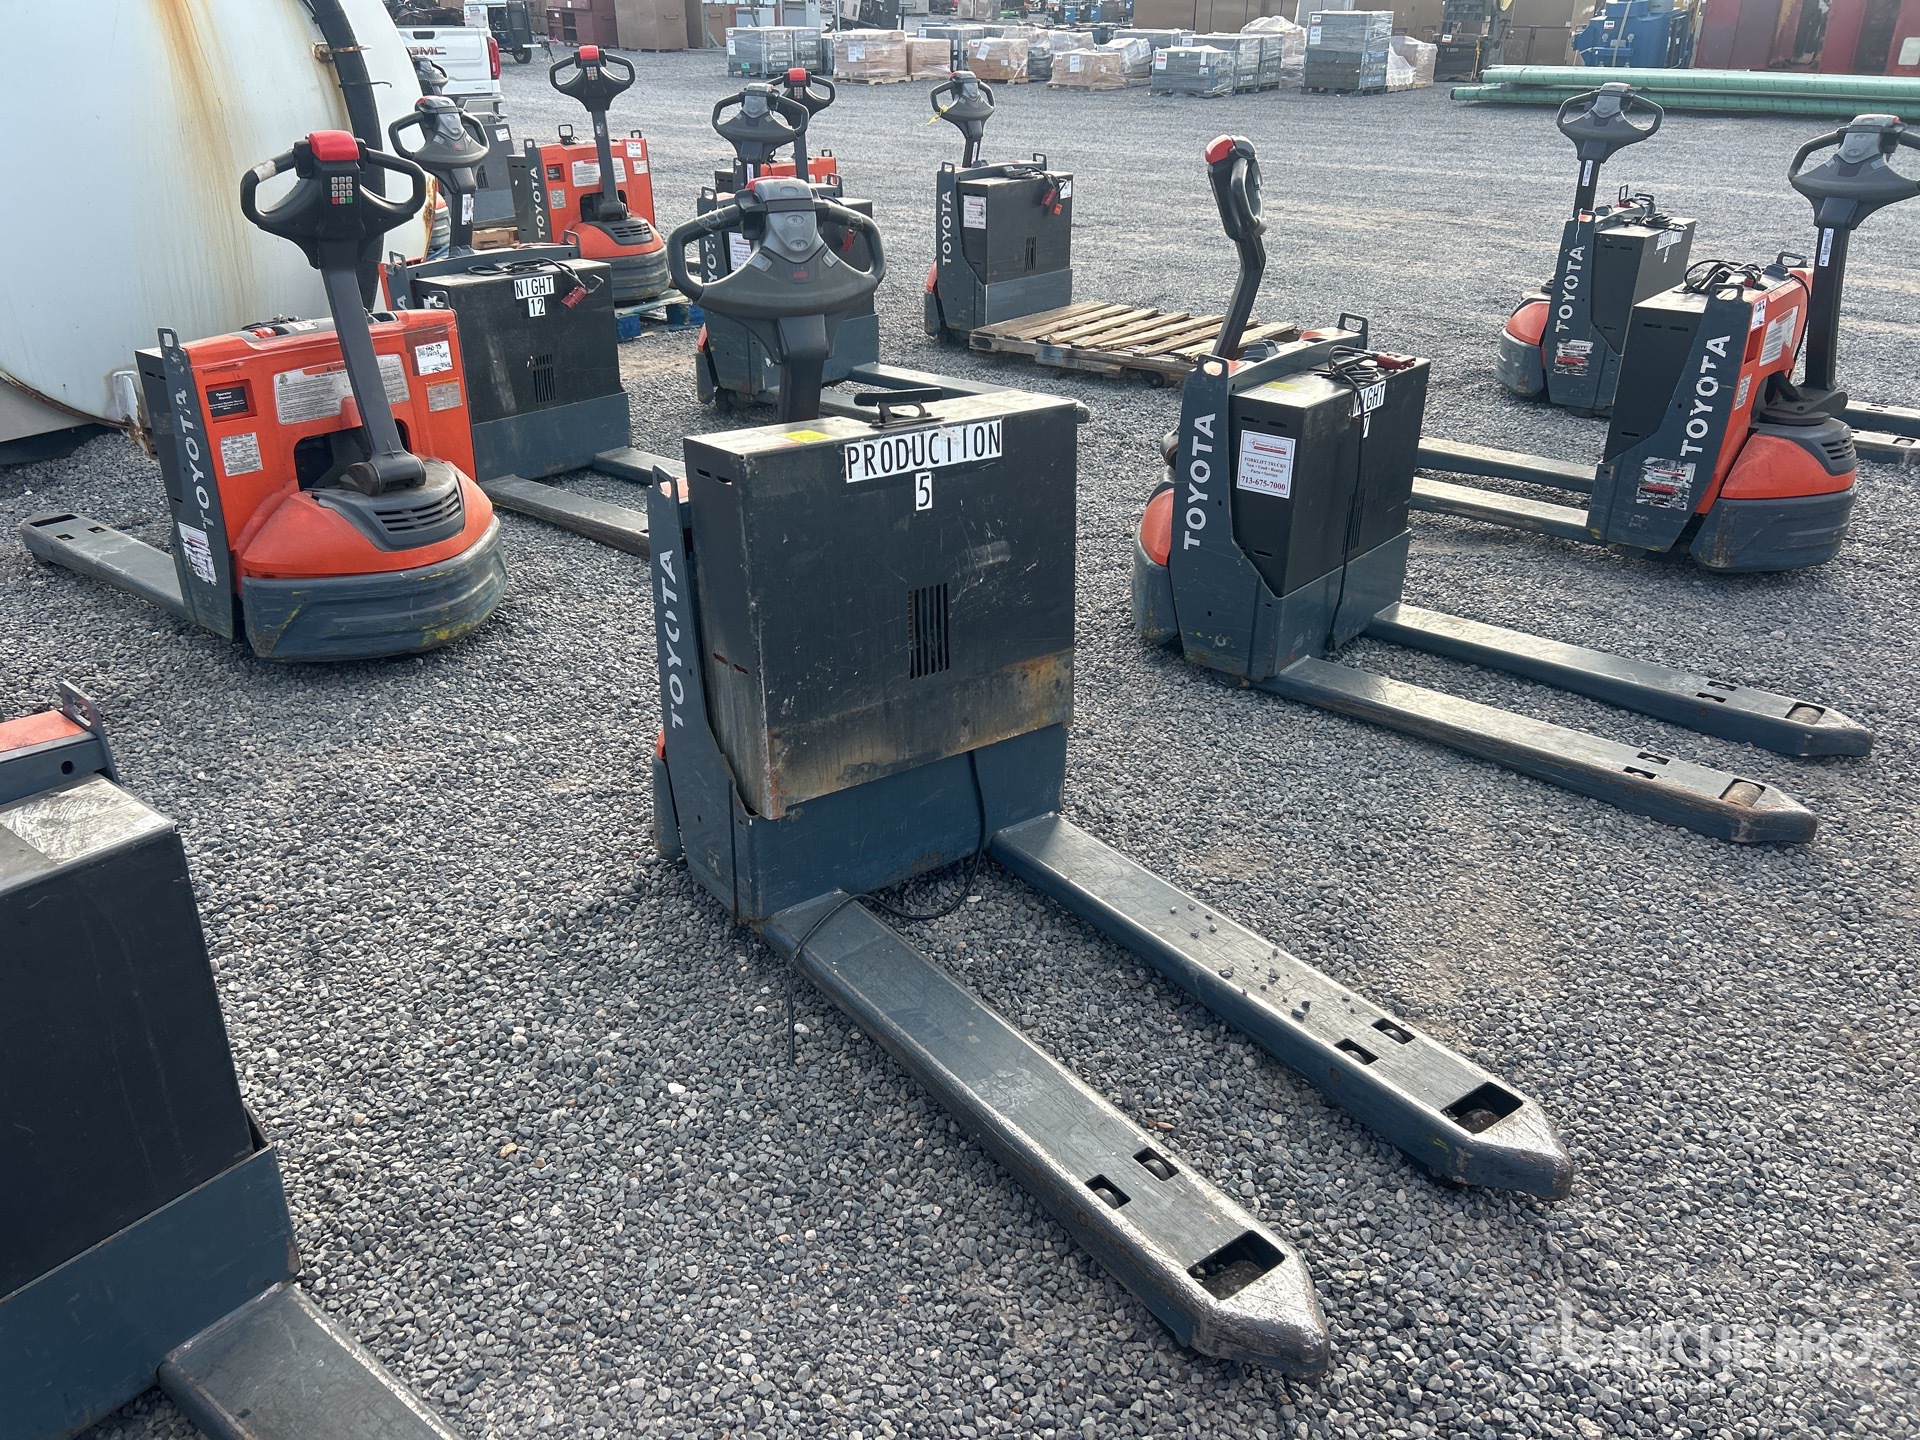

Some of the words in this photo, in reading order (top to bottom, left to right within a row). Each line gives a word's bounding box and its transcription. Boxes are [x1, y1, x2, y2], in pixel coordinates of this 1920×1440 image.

[530, 166, 546, 238] TOYOTA
[941, 190, 952, 266] TOYOTA
[515, 276, 554, 298] NIGHT
[530, 298, 545, 316] 12
[1555, 245, 1586, 333] TOYOTA
[1680, 335, 1731, 457] TOYOTA
[847, 422, 1001, 480] PRODUCTION
[1183, 413, 1216, 551] TOYOTA
[1241, 475, 1286, 491] 713-675-7000
[1244, 457, 1267, 466] FORKLIFT
[1268, 461, 1287, 469] TRUCKS
[917, 474, 931, 508] 5
[659, 549, 685, 730] TOYOTA
